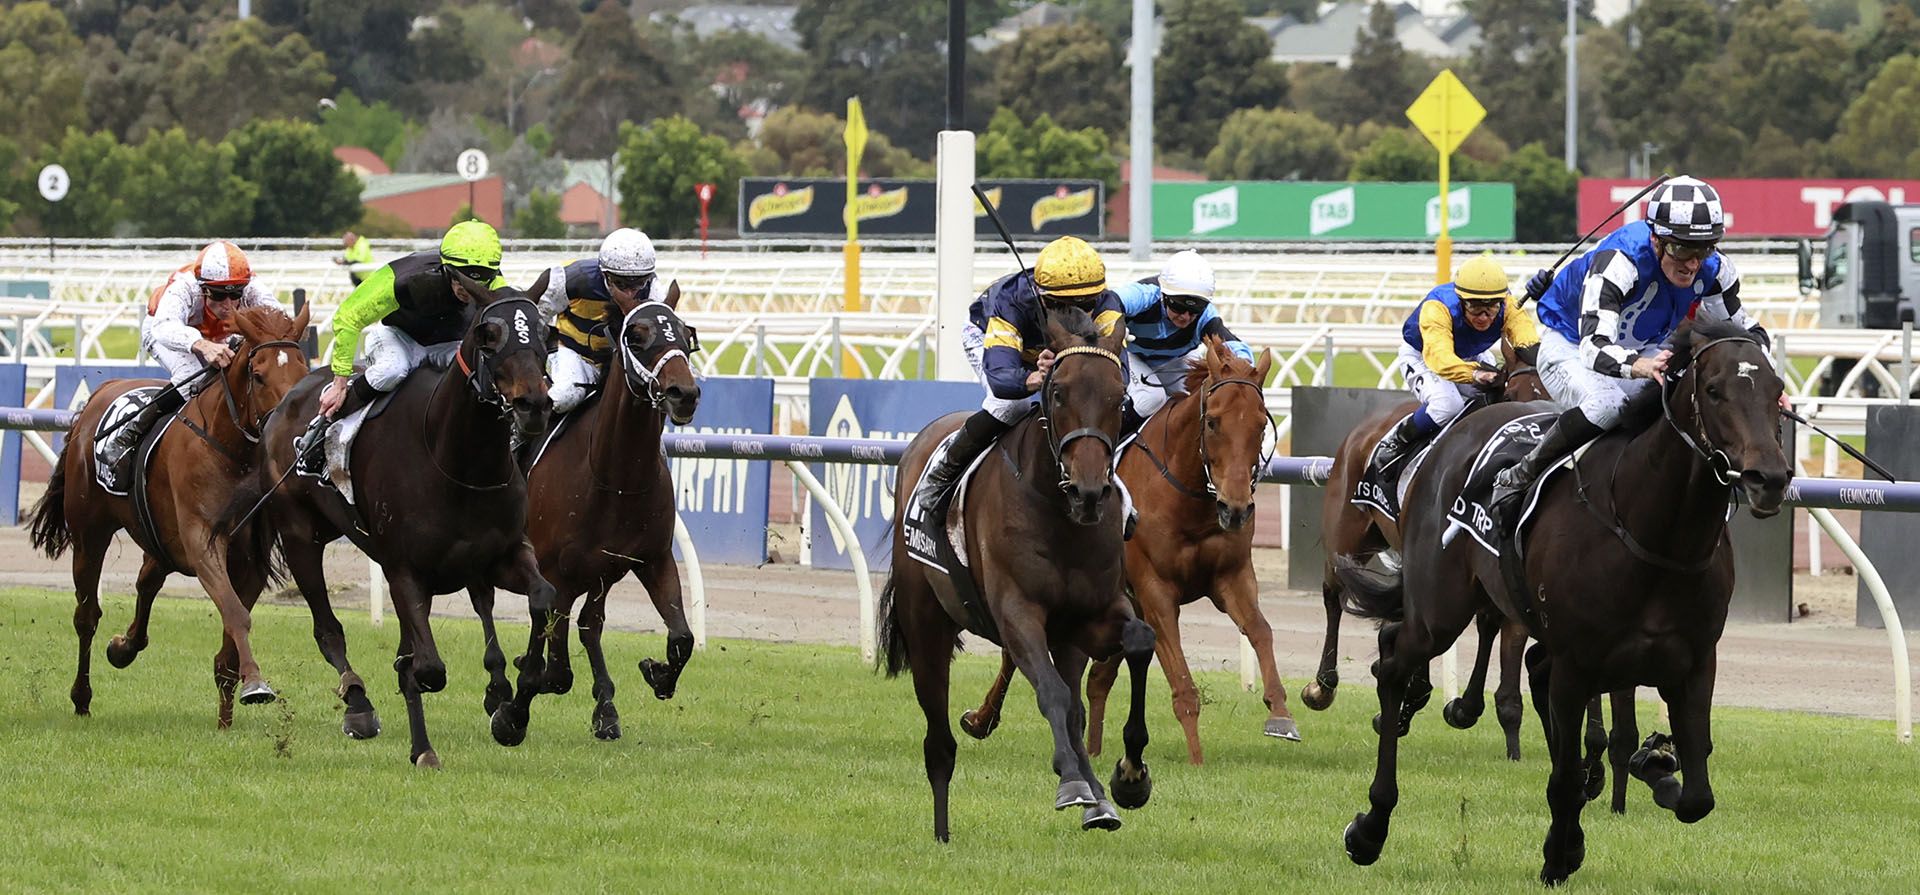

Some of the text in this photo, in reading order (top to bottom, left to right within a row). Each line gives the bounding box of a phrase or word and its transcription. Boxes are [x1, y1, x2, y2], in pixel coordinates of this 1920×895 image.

[466, 154, 478, 174] 8
[48, 175, 58, 190] 2
[1200, 202, 1231, 219] TAB
[1317, 202, 1349, 220] TAB
[1433, 203, 1464, 220] TB
[1840, 487, 1885, 504] FLEMINGTON
